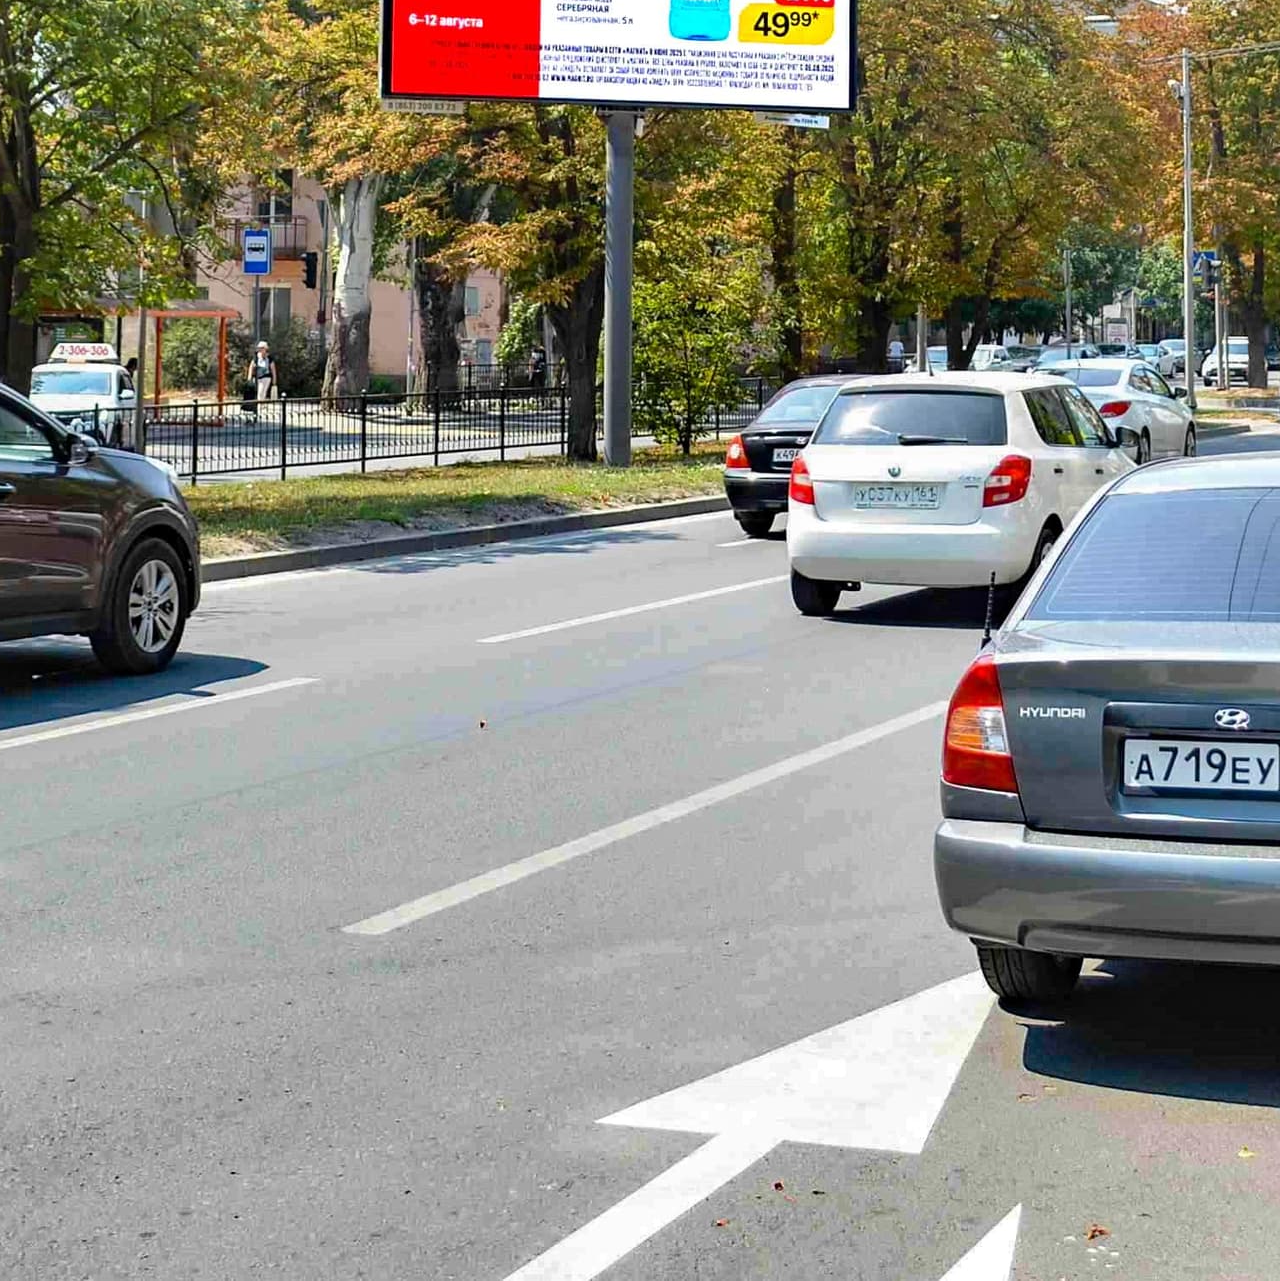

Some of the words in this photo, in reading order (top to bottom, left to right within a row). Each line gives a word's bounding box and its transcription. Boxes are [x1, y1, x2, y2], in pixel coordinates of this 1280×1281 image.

[556, 3, 610, 13] СЕРЕБРЯНАЯ
[440, 17, 484, 29] августа
[59, 345, 109, 356] 2-306-306
[1019, 706, 1086, 719] HYUNDAI
